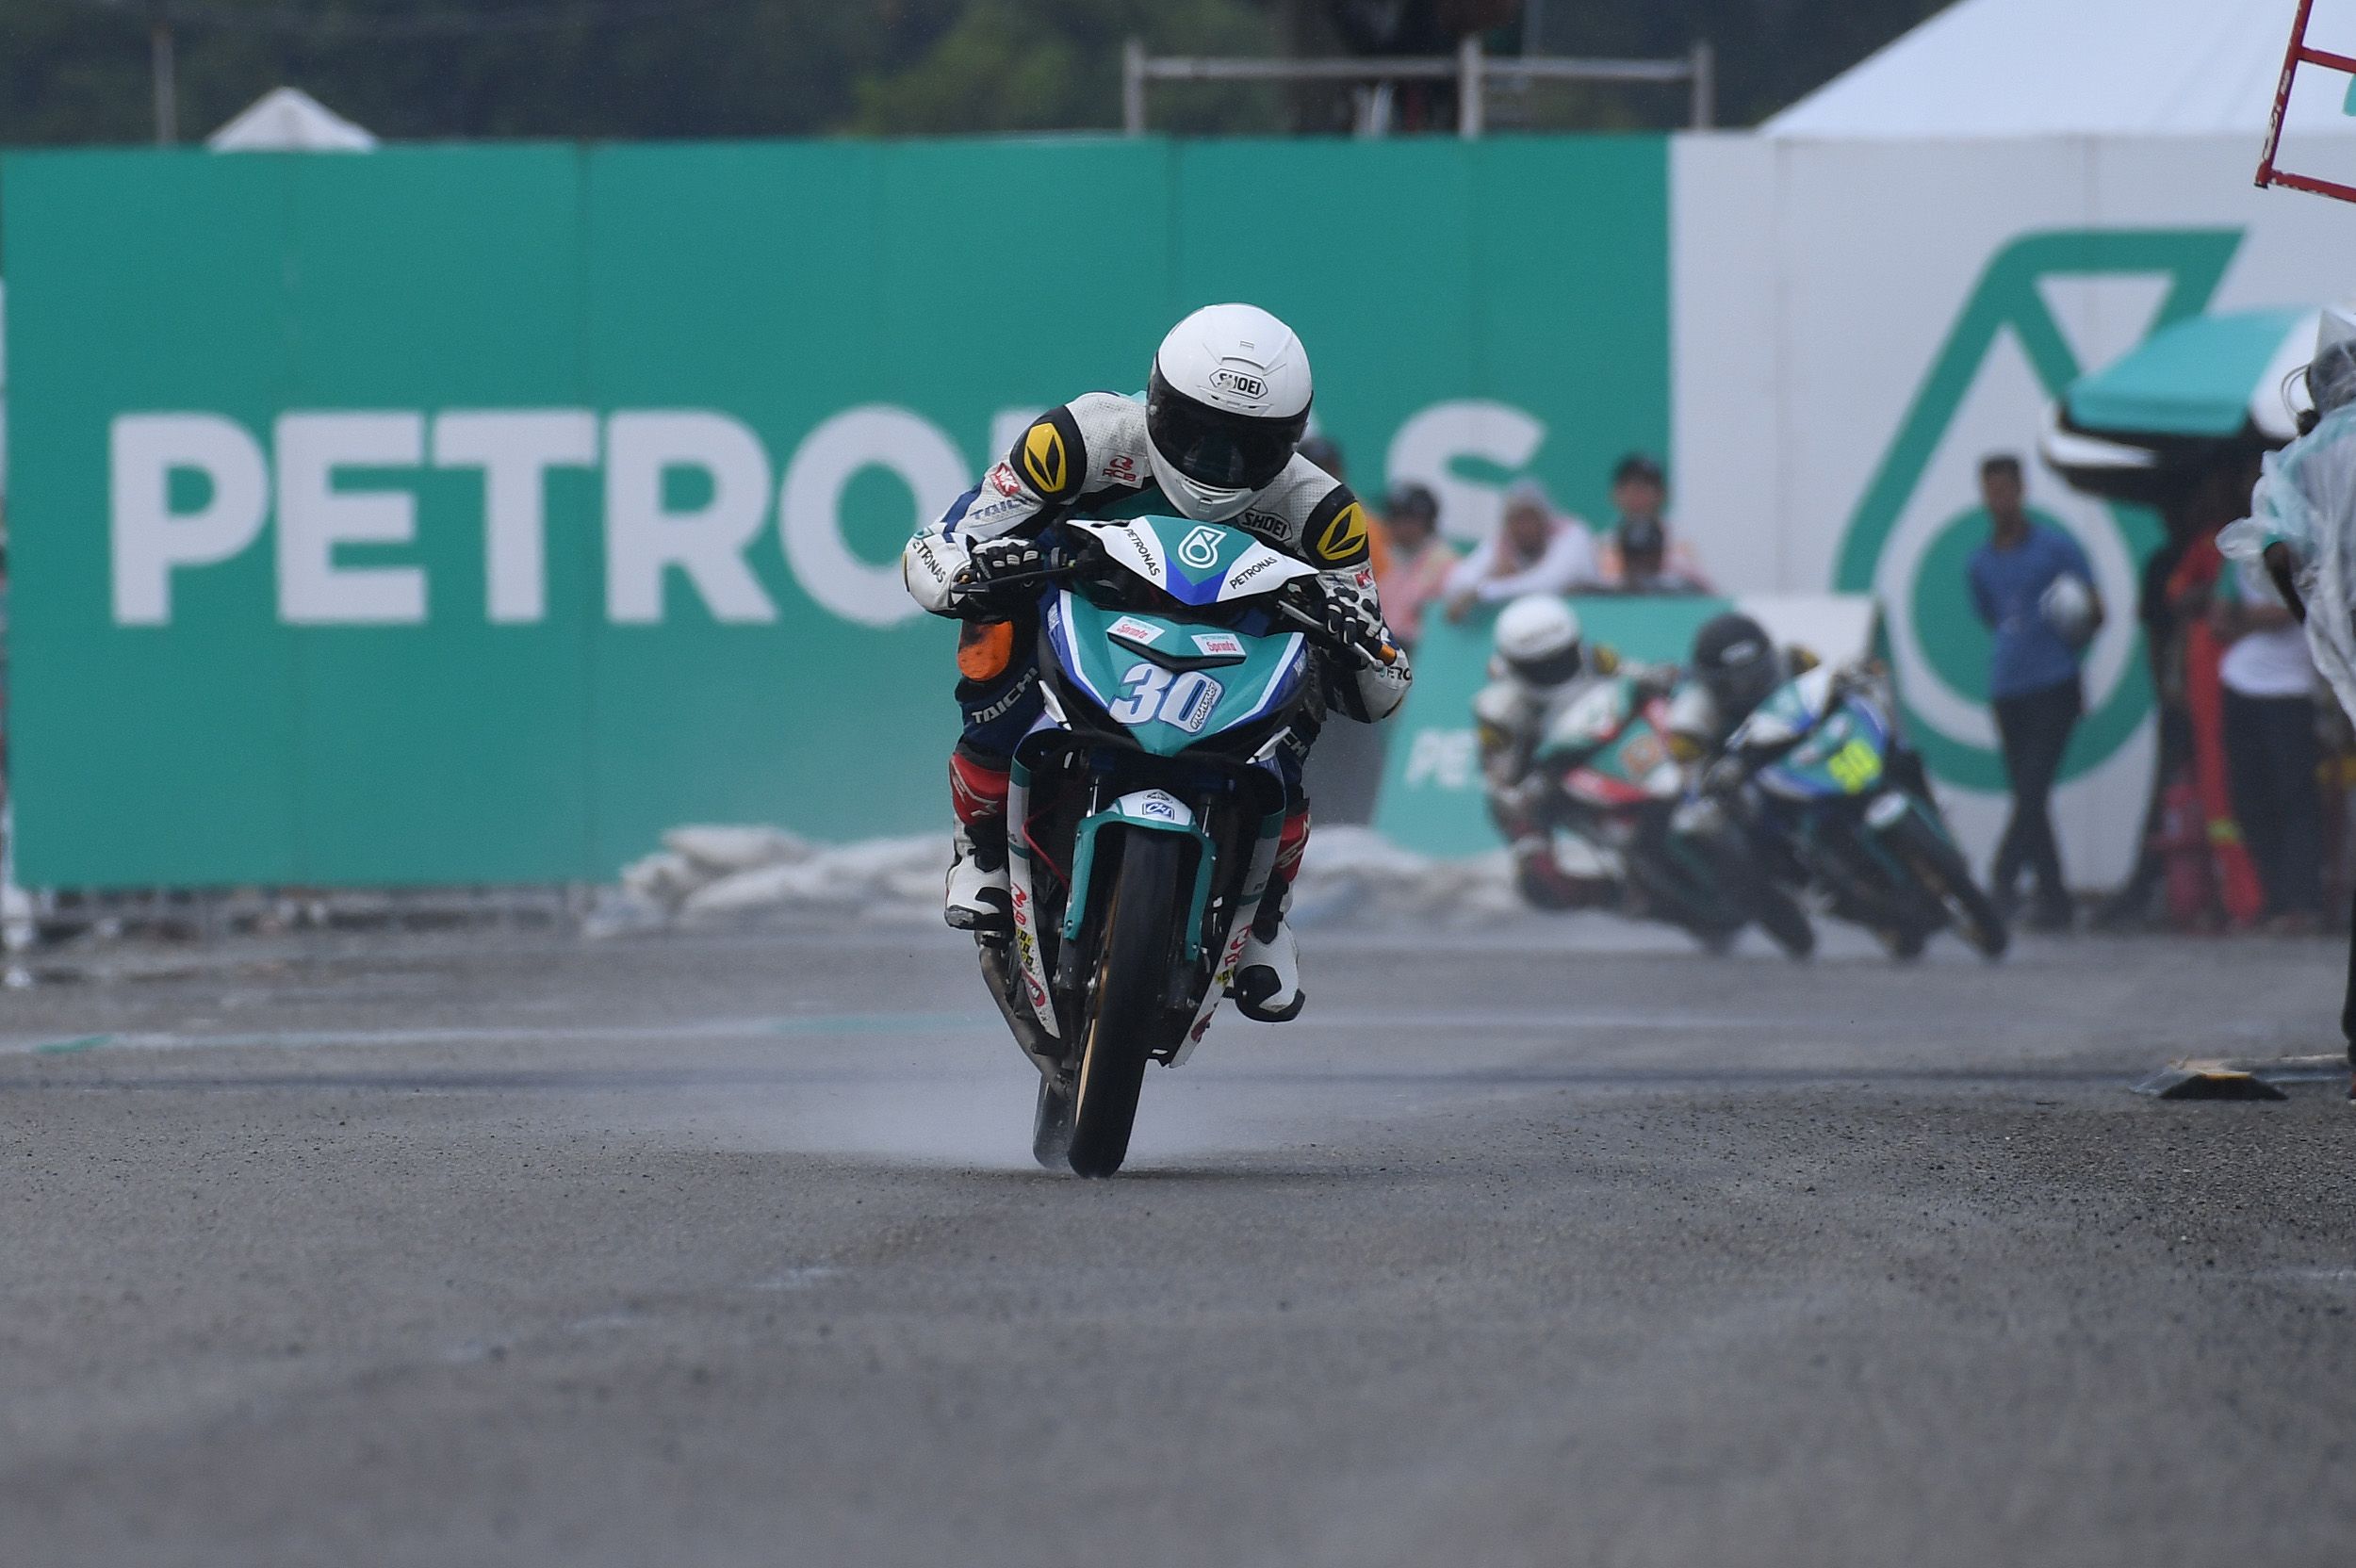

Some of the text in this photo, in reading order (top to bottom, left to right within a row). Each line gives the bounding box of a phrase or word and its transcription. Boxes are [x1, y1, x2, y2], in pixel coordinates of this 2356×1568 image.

[109, 400, 1546, 629] PETROS
[1242, 512, 1287, 538] SHOEI
[1124, 528, 1161, 577] PETRONAS
[1229, 556, 1278, 590] PETRONAS
[972, 667, 1038, 724] TAICHI
[1108, 662, 1225, 737] 30
